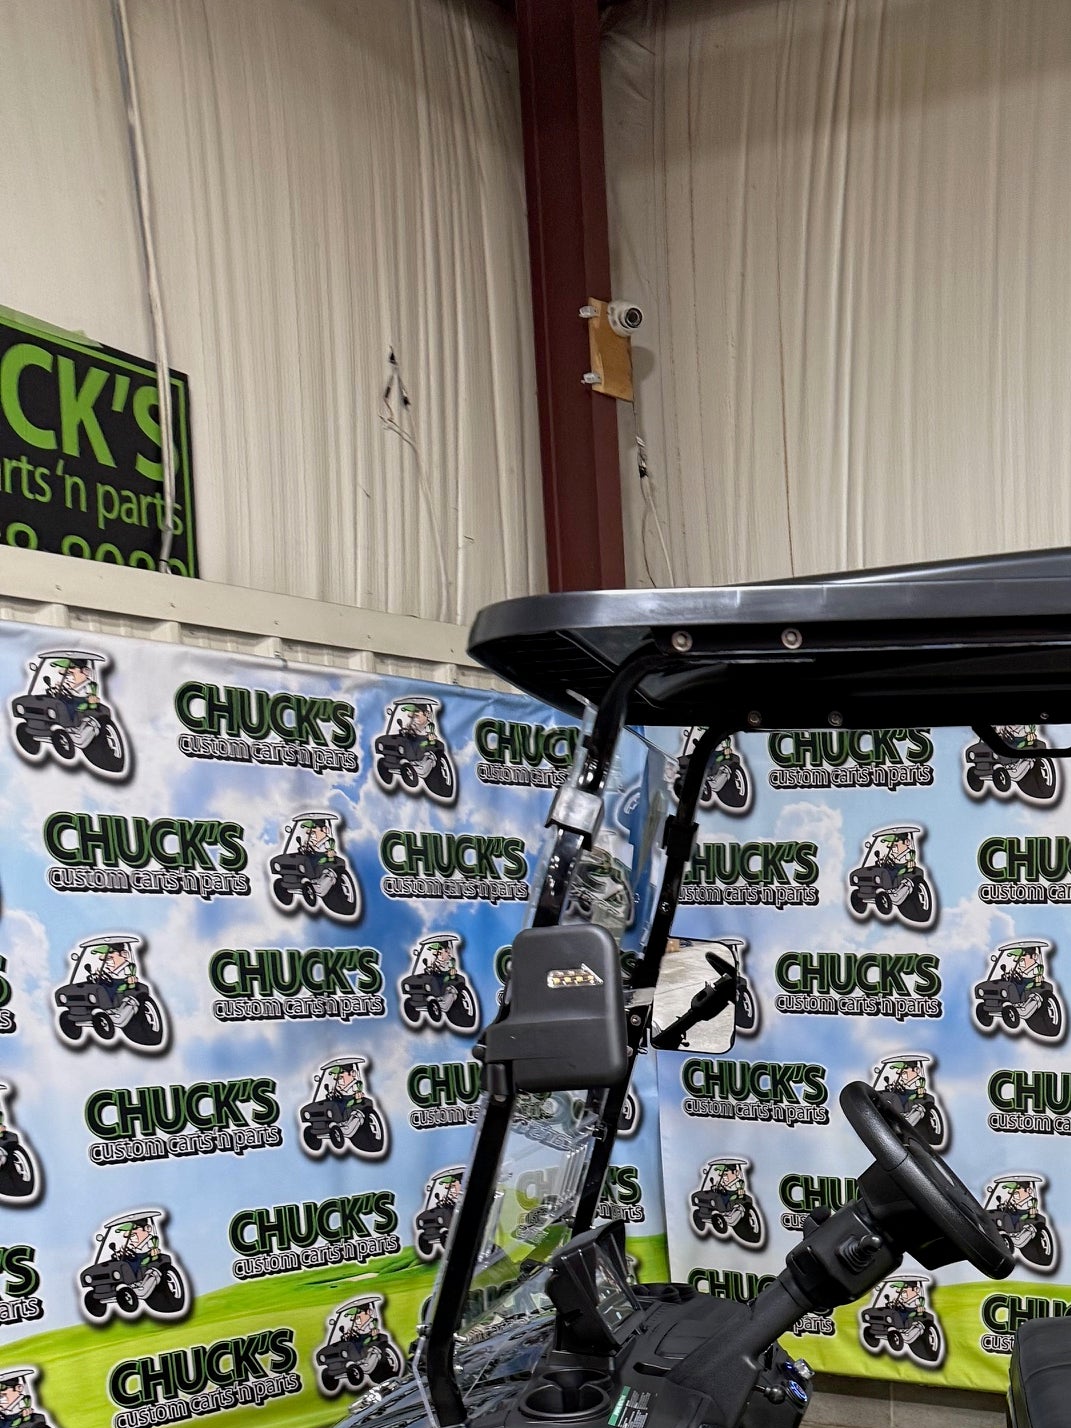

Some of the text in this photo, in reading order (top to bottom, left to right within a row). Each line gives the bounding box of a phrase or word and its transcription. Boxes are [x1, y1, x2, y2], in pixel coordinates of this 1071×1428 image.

[0, 343, 181, 482] CK'S
[95, 482, 185, 536] parts
[174, 681, 357, 749] CHUCK'S
[178, 733, 251, 760] custom
[312, 747, 359, 774] parts
[475, 718, 580, 767] CHUC
[768, 729, 933, 767] CHUCK'S
[477, 763, 530, 785] custom
[769, 767, 831, 788] custom
[886, 764, 933, 790] parts
[43, 811, 248, 872] CHUCK'S
[380, 830, 527, 880] CHUCK'S
[48, 867, 130, 892] custom
[199, 871, 250, 899] parts
[682, 841, 819, 885] HUCK'S
[382, 876, 442, 898] custom
[490, 881, 529, 904] parts
[775, 885, 818, 909] parts
[978, 881, 1047, 904] custom
[209, 948, 383, 997] CHUCK'S
[775, 952, 941, 997] CHUCK'S
[213, 998, 284, 1021] custom
[339, 995, 386, 1020] parts
[775, 993, 837, 1014] custom
[895, 996, 942, 1021] parts
[681, 1057, 828, 1105] CHUCK'S
[84, 1077, 280, 1140] CHUCK'S
[410, 1104, 466, 1130] custom
[684, 1097, 735, 1118] custom
[785, 1104, 829, 1127] parts
[988, 1113, 1053, 1134] custom
[89, 1136, 167, 1164] custom
[232, 1125, 283, 1154] parts
[228, 1190, 398, 1256] CHUCK'S
[233, 1252, 300, 1279] custom
[356, 1234, 401, 1264] parts
[109, 1328, 297, 1409] CHUCK'S
[252, 1373, 303, 1406] parts
